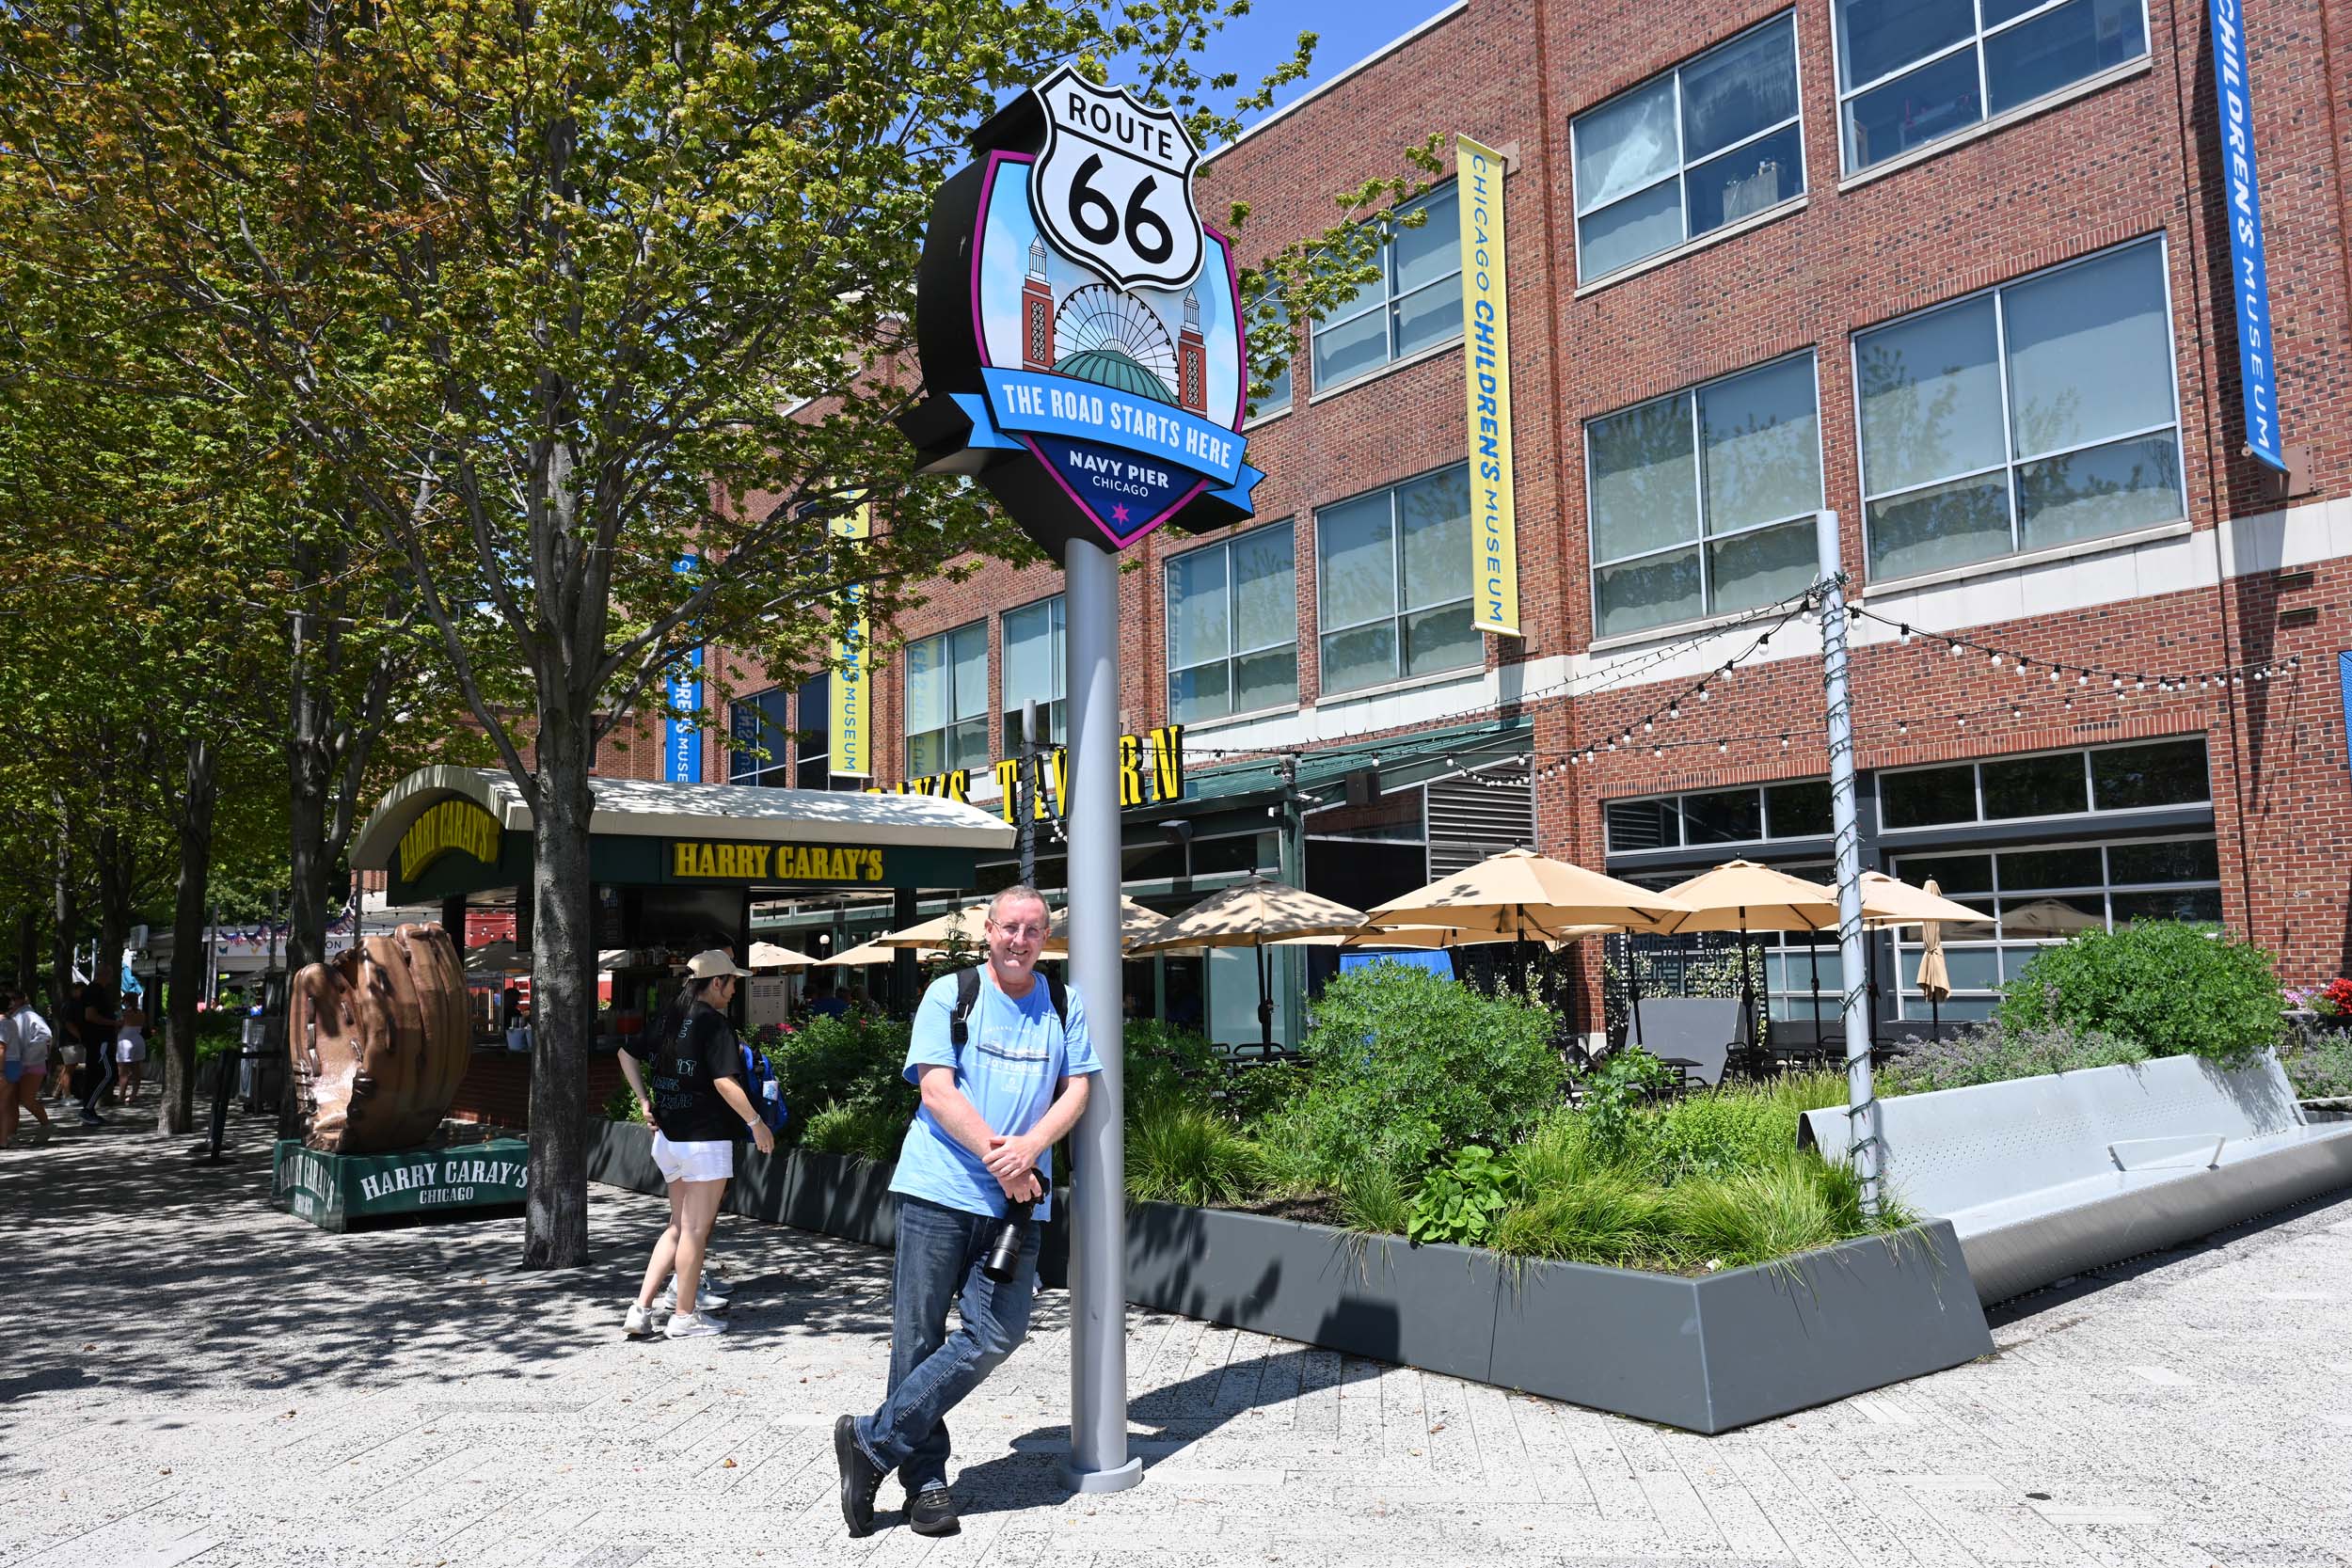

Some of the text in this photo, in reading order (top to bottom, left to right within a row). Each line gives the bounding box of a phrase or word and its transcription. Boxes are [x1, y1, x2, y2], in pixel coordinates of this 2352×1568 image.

[1068, 90, 1173, 162] ROUTE
[1068, 152, 1174, 264] 66
[2242, 262, 2270, 449] MUSEUM
[1472, 154, 1503, 624] CHICAGO CHILDREN'S MUSEUM
[1002, 383, 1232, 470] THE ROAD STARTS HERE
[1069, 450, 1169, 489] NAVY PIER
[1091, 475, 1150, 499] CHICAGO
[843, 687, 857, 770] MUSEUM
[676, 737, 689, 783] MUSE
[673, 843, 883, 880] HARRY CARAY'S
[360, 1160, 529, 1201] HARRY CARAY'S
[420, 1186, 474, 1205] CHICAGO
